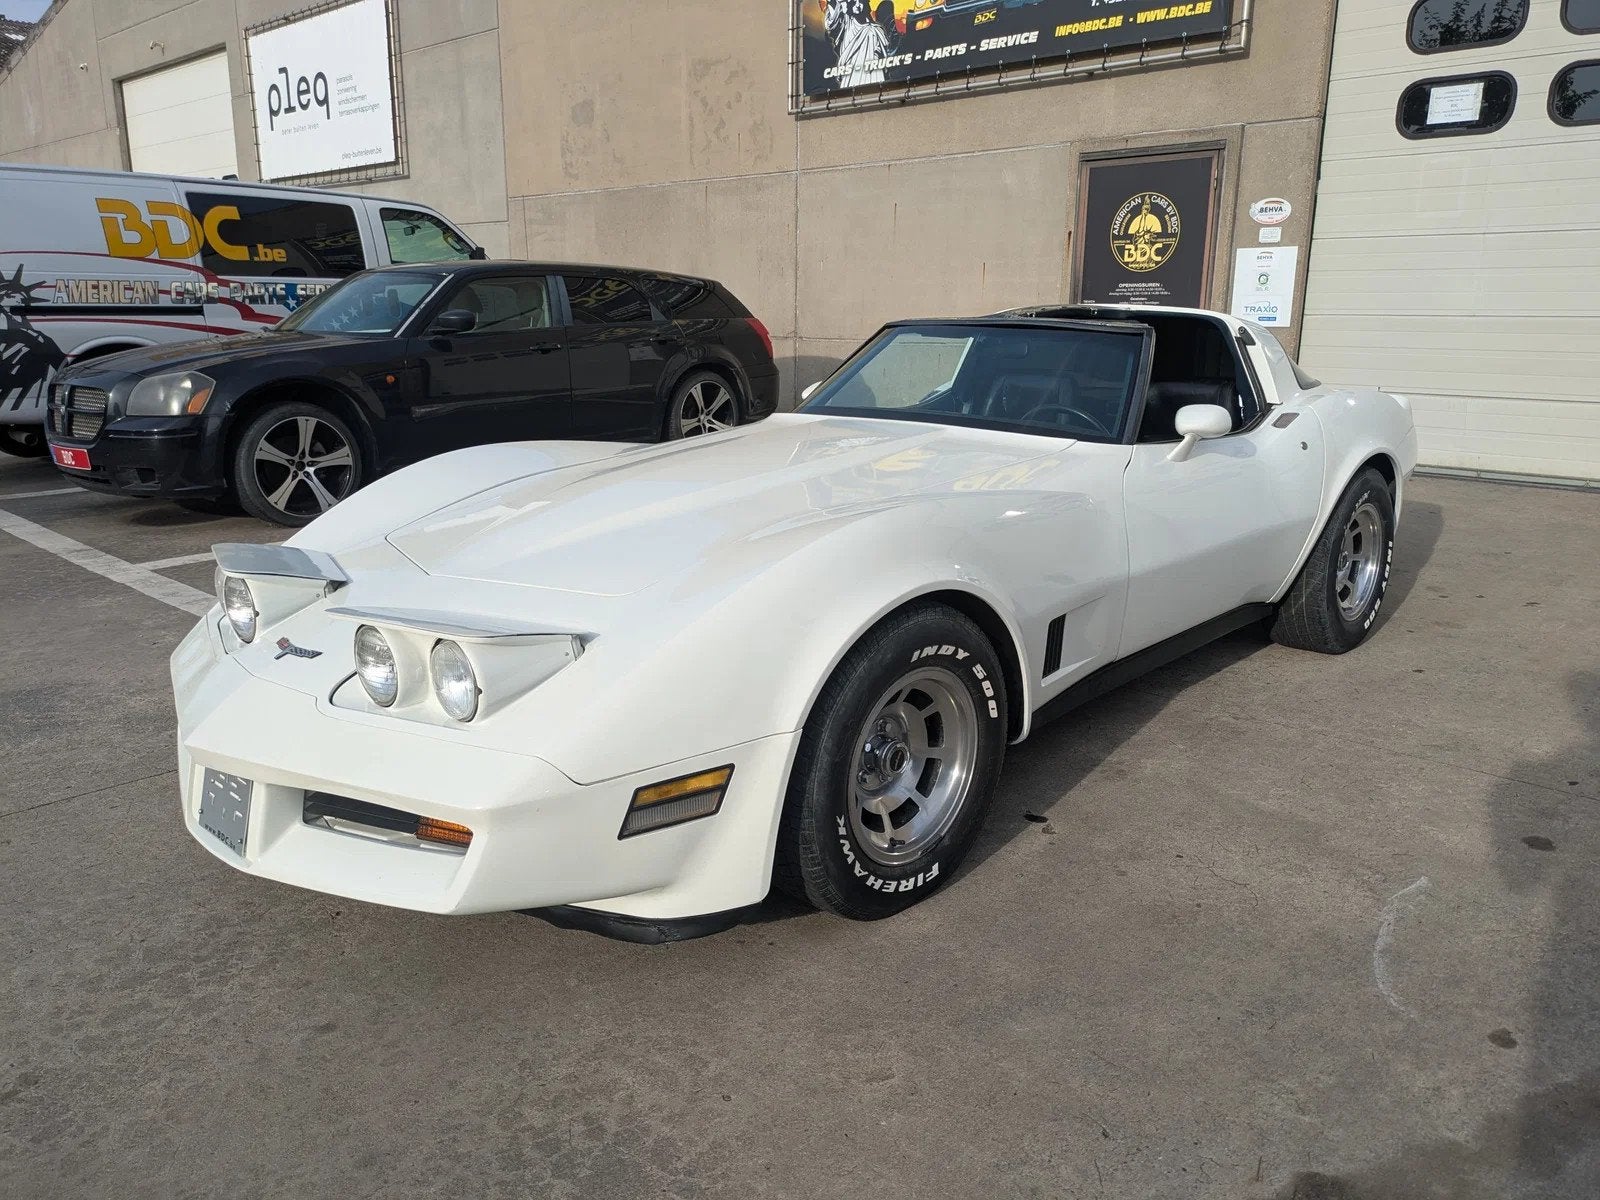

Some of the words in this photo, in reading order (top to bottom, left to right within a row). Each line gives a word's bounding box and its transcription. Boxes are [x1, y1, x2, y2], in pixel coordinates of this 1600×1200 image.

[974, 11, 998, 24] BDC
[1055, 15, 1124, 38] INFO@BDC.BE
[1136, 1, 1213, 24] WWW.BDC.BE
[823, 64, 852, 79] CARS
[864, 53, 913, 72] TRUCK'S
[924, 43, 967, 61] PARTS
[979, 30, 1040, 52] SERVICE
[268, 67, 330, 131] pleq
[1151, 195, 1169, 213] CARS
[1166, 205, 1176, 217] BY
[1259, 206, 1284, 214] BEHVA
[1112, 197, 1142, 235] AMERICAN
[1170, 216, 1179, 234] BDC
[1124, 243, 1163, 262] BDC
[52, 279, 159, 304] AMERICAN
[170, 281, 219, 304] CARS
[230, 282, 286, 305] PARTS
[1244, 305, 1278, 314] TRAXIO
[911, 644, 970, 663] INDY
[972, 663, 998, 719] 500
[836, 814, 940, 893] FIREHAWK
